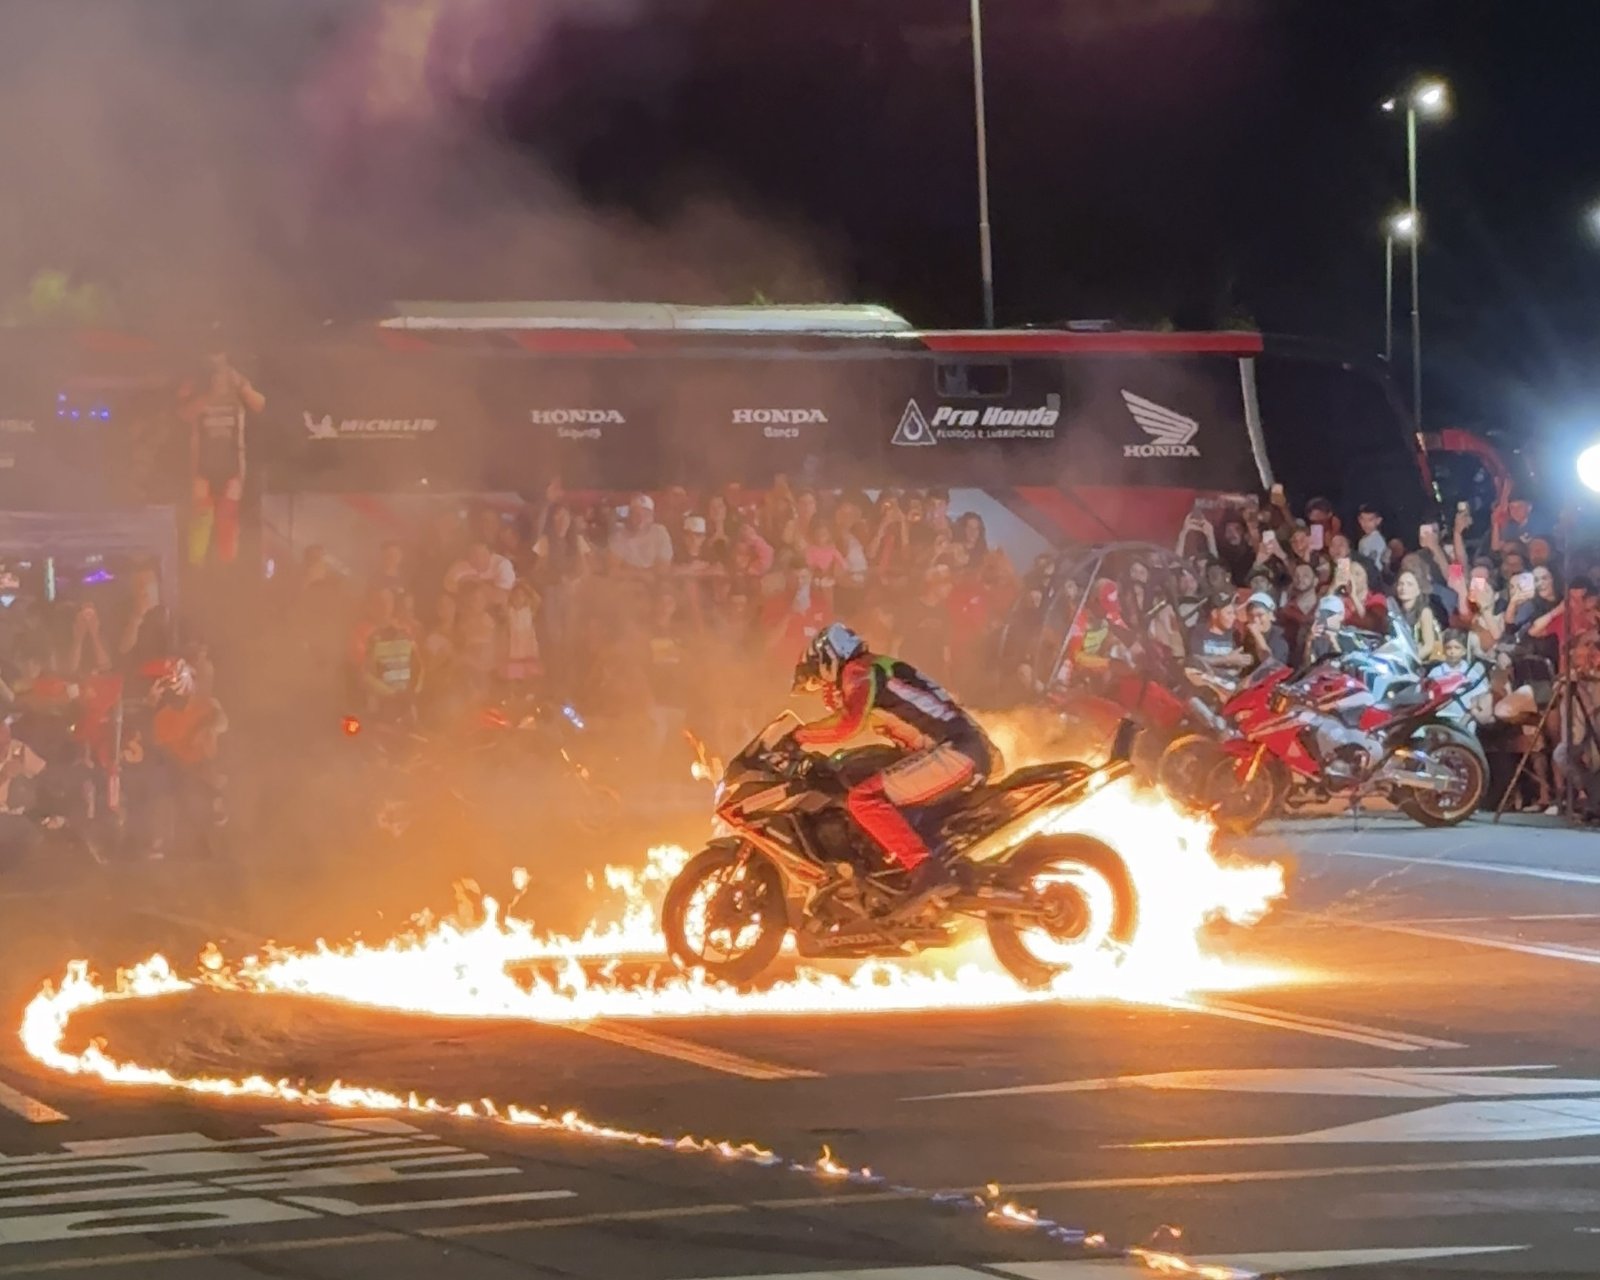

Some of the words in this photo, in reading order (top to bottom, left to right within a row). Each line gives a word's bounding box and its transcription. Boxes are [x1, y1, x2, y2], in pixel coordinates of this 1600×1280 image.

[530, 408, 626, 424] HONDA
[732, 408, 828, 424] HONDA
[931, 406, 980, 426] Pro
[981, 405, 1059, 426] Honda
[341, 418, 438, 432] MICHELIN
[1123, 445, 1200, 457] HONDA
[816, 933, 884, 948] HONDA
